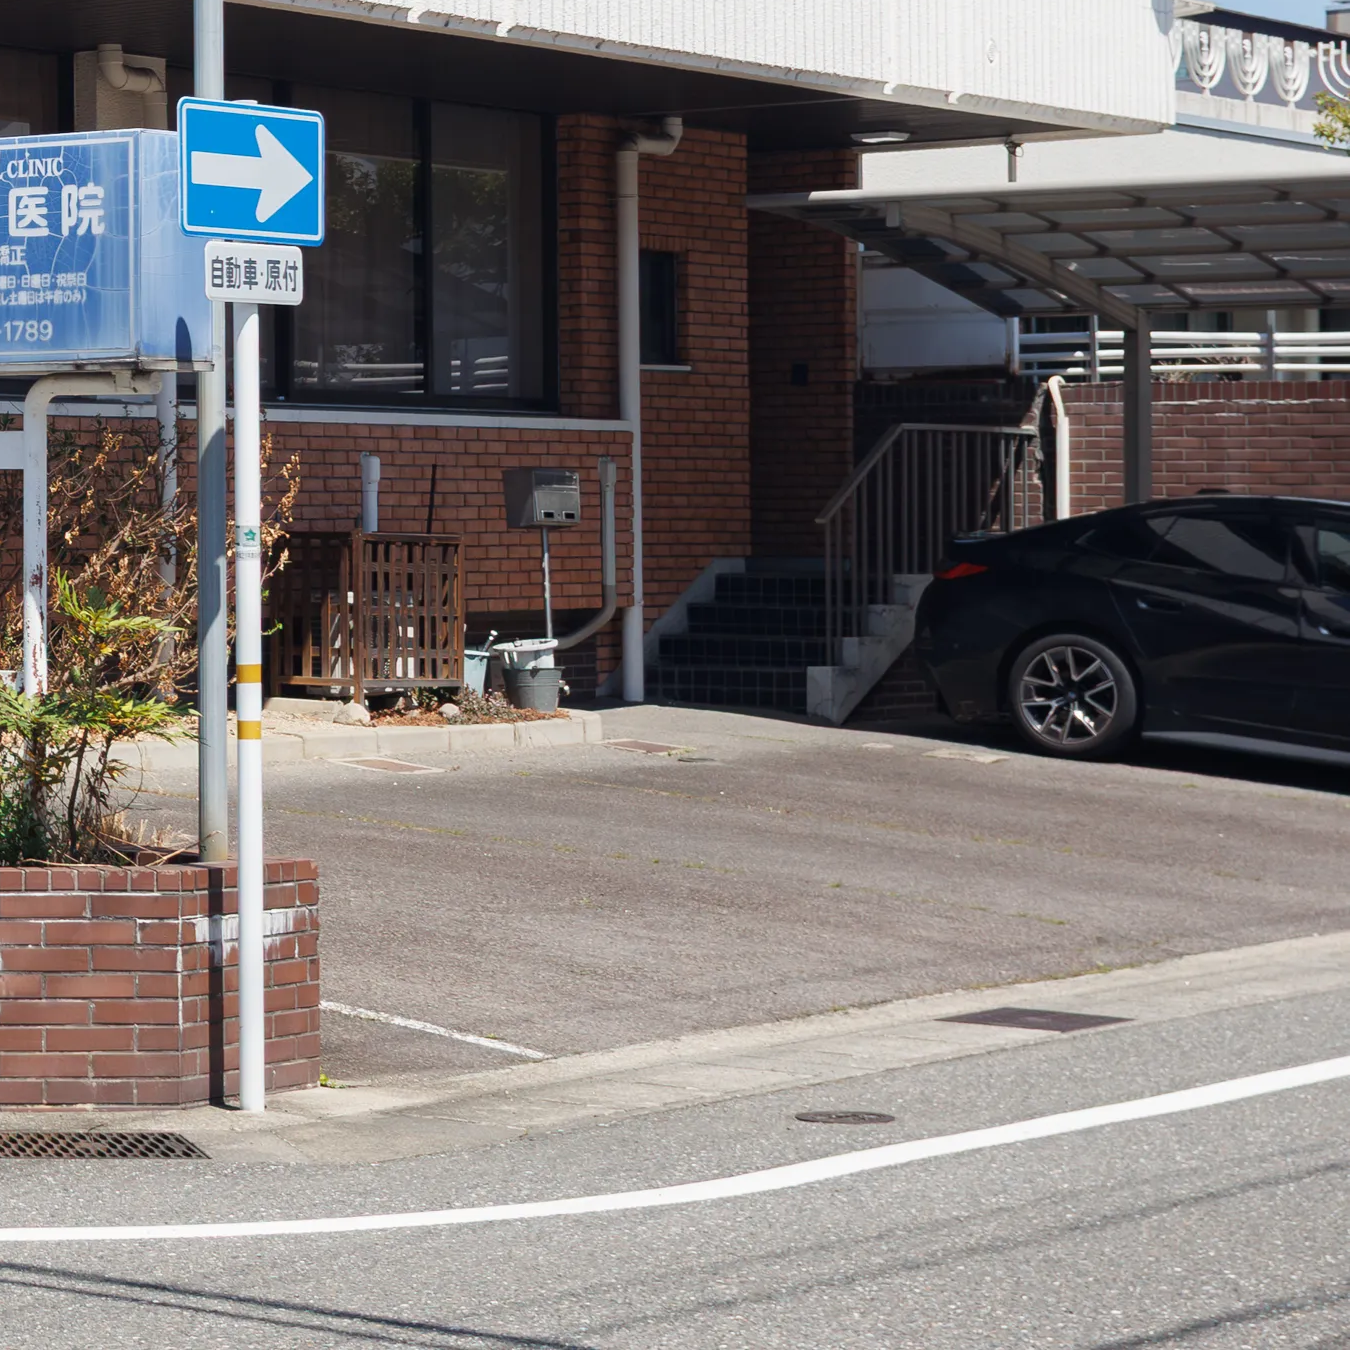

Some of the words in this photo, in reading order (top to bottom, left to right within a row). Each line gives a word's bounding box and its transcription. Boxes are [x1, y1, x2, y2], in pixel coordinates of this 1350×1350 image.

[7, 157, 64, 179] CLINIC
[211, 255, 299, 292] 自動車・原付
